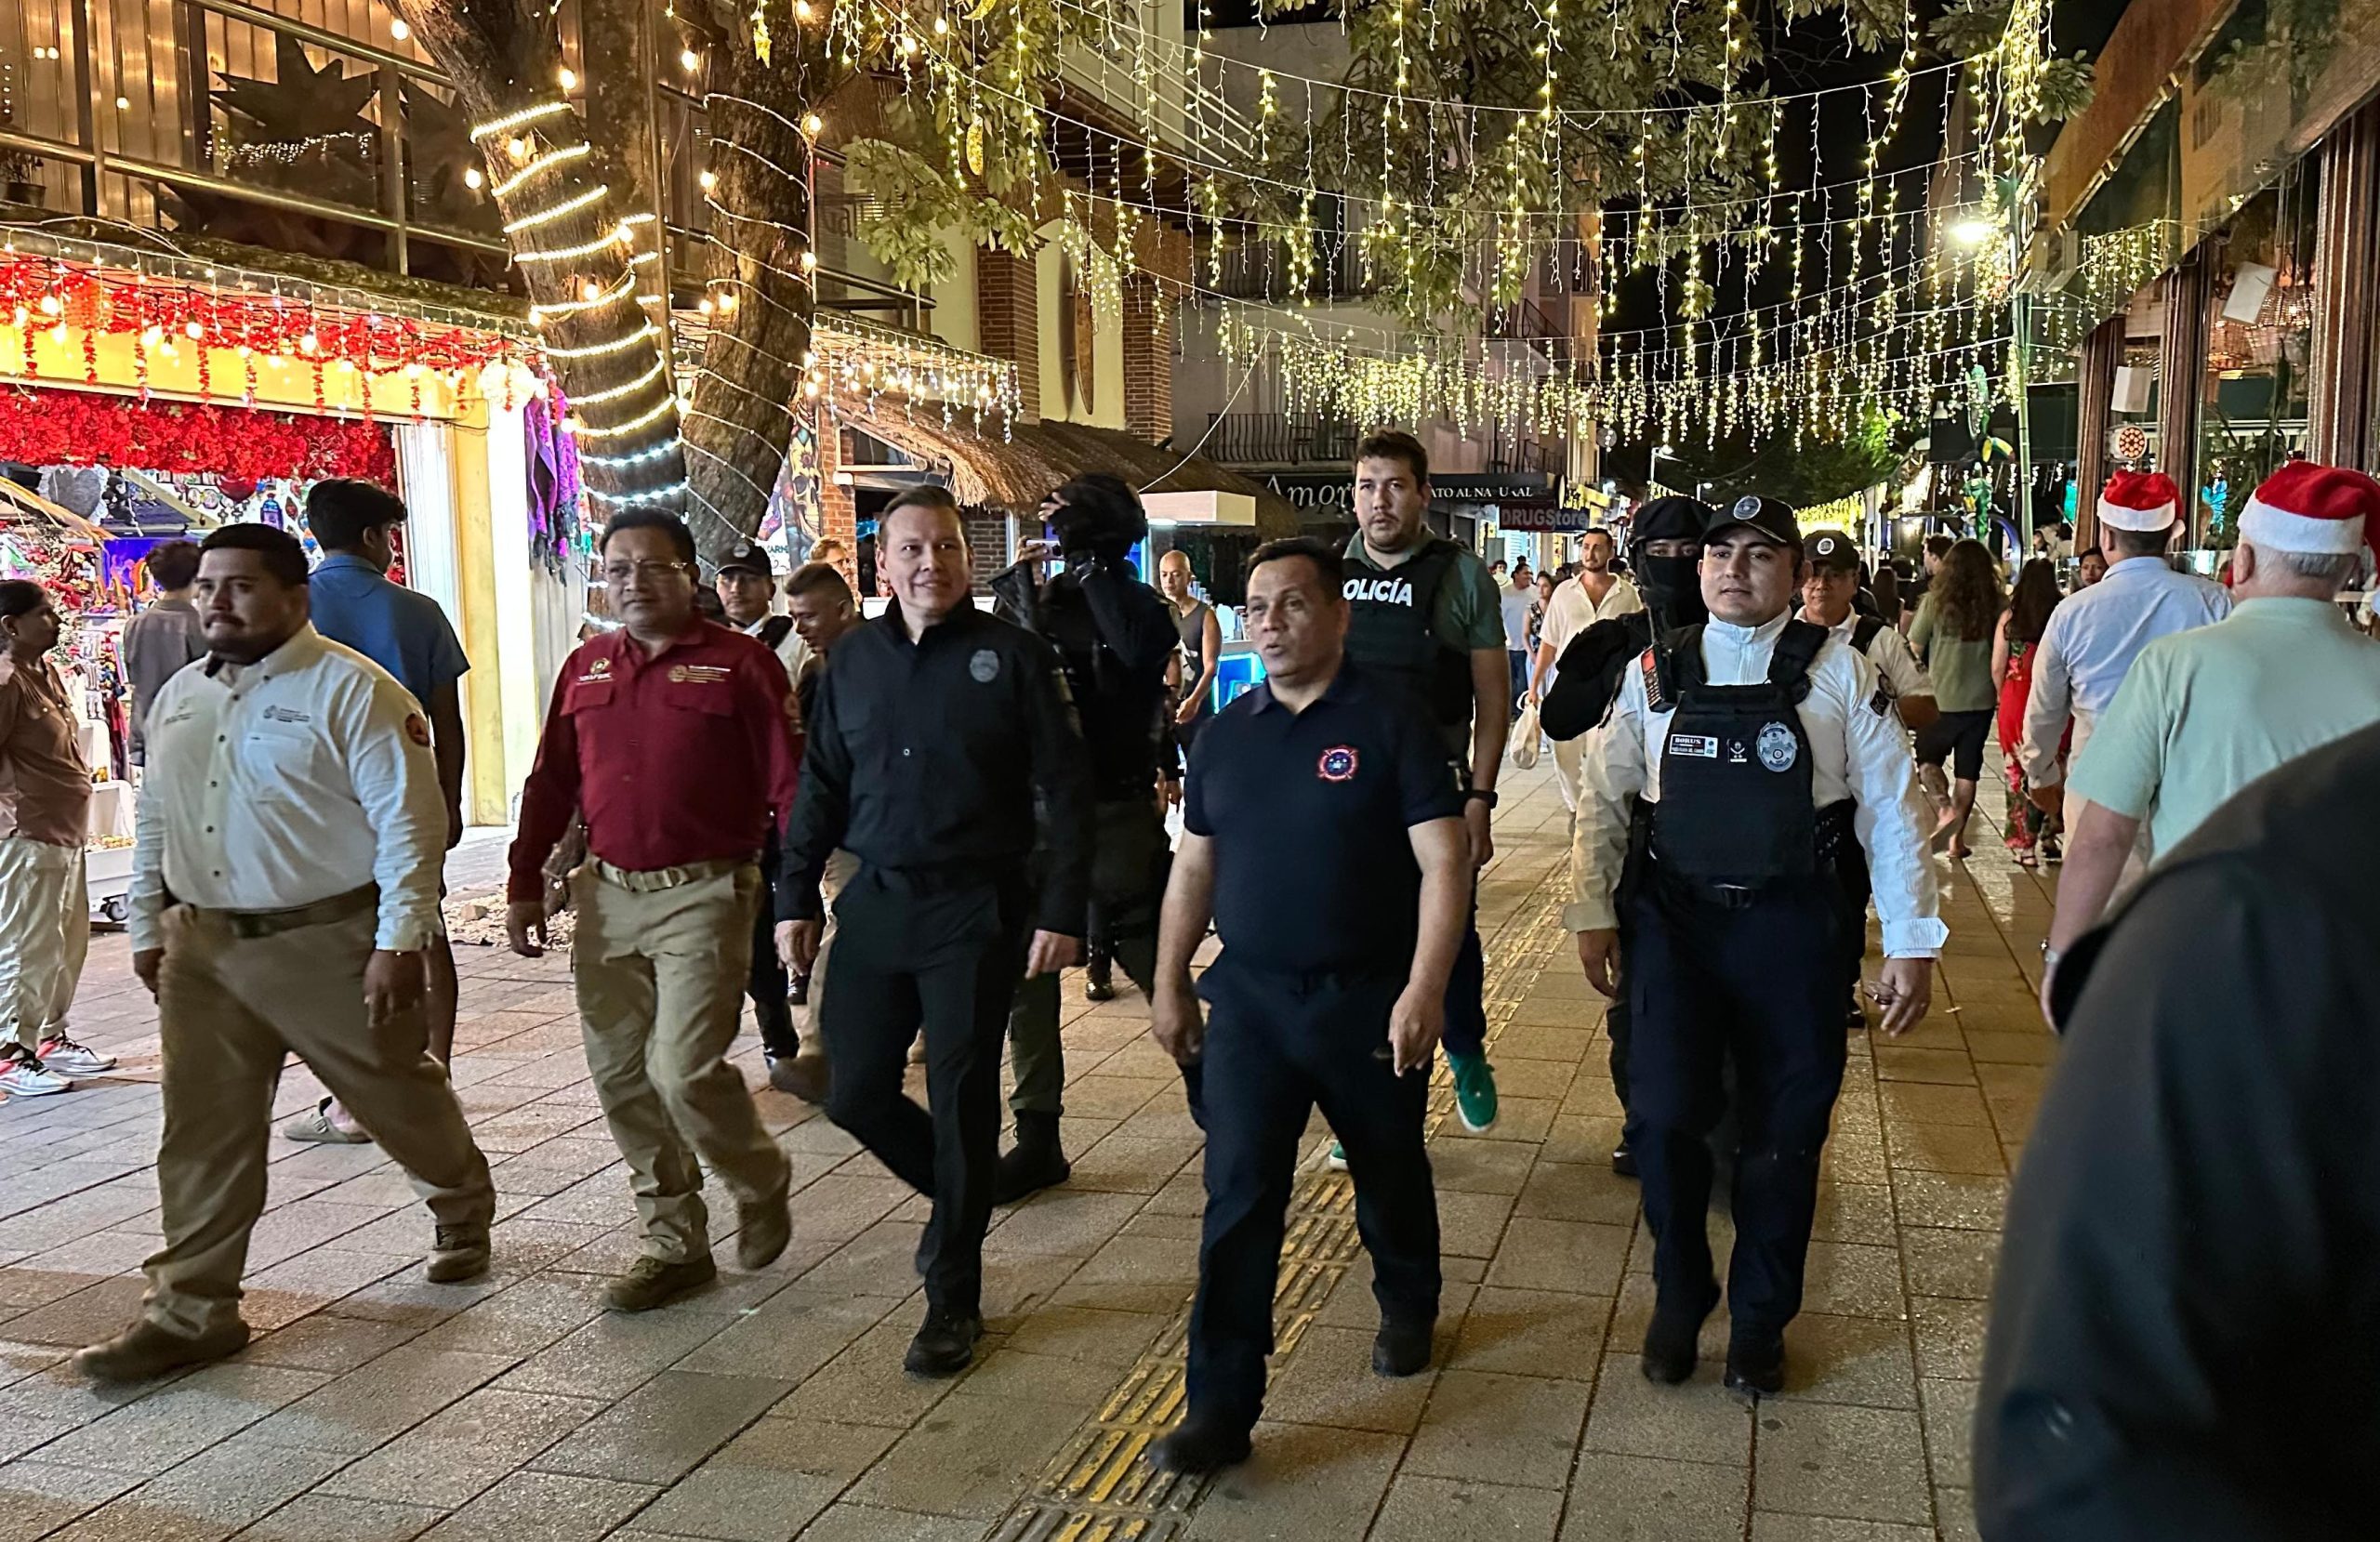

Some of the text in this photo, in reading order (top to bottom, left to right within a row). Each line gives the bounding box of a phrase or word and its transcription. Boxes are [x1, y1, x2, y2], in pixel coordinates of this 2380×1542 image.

[1456, 487, 1472, 498] AL
[1501, 507, 1589, 528] DRUGStore
[1342, 577, 1412, 607] OLICÍA
